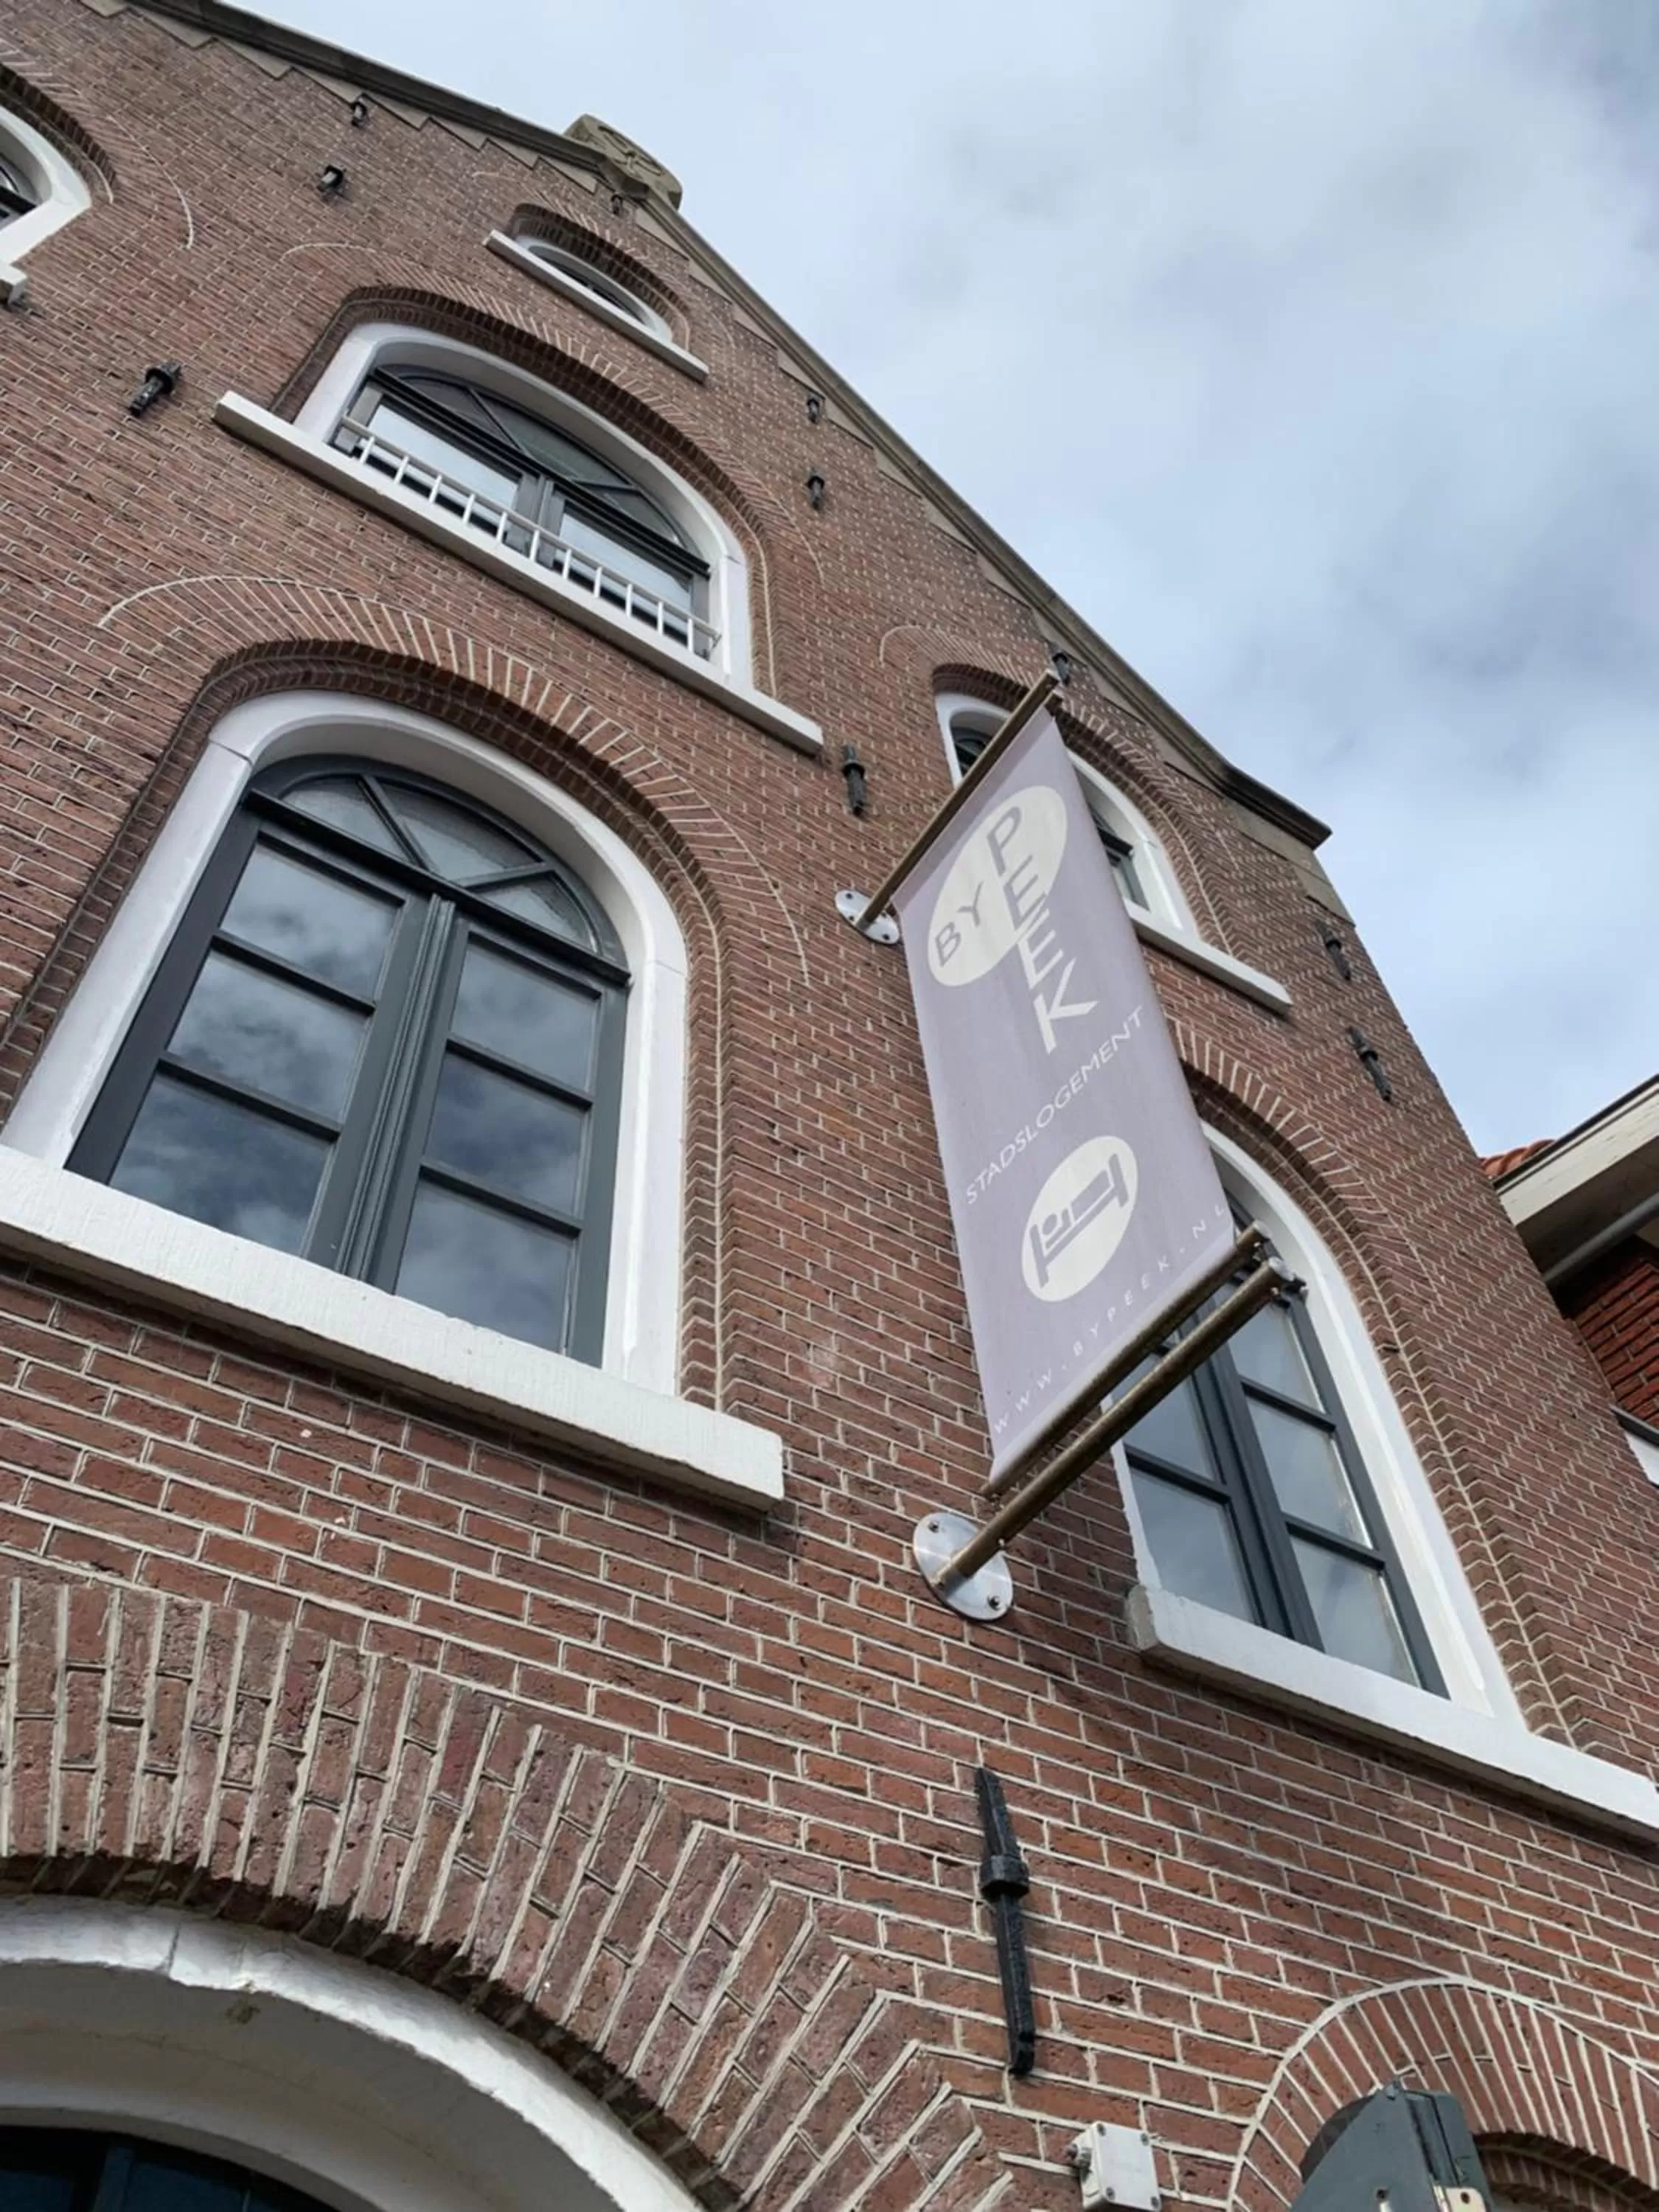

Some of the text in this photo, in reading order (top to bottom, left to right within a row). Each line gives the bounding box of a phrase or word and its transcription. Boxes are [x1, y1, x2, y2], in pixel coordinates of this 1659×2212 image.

[934, 881, 984, 968] BY
[986, 806, 1099, 1054] PEEK
[966, 1005, 1143, 1204] STADSLOGEMENT
